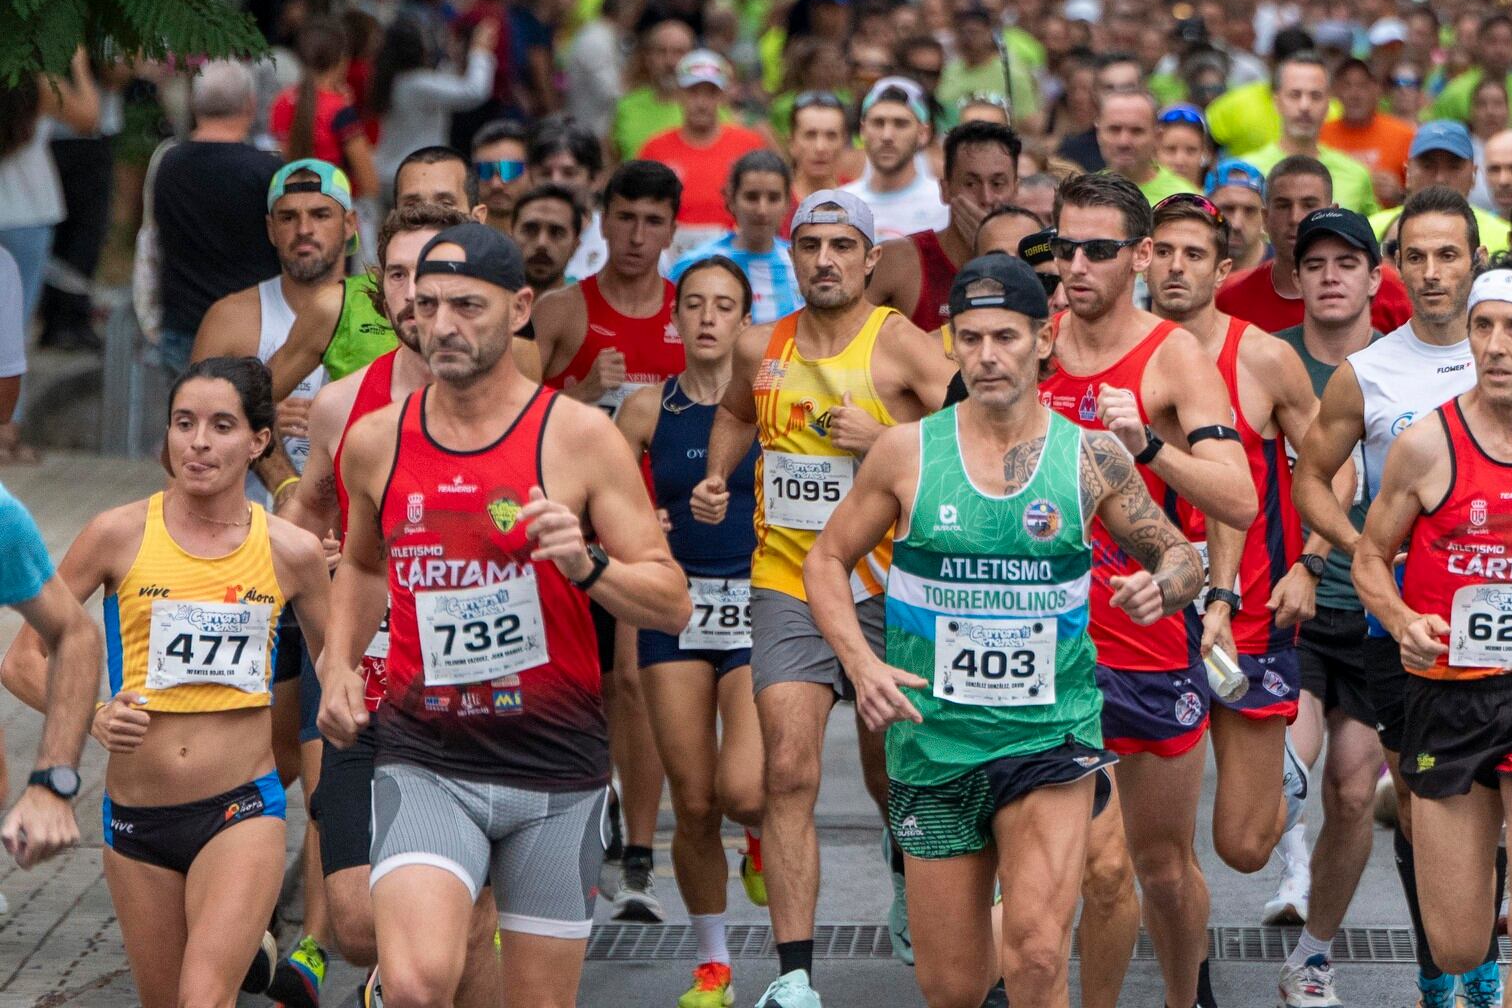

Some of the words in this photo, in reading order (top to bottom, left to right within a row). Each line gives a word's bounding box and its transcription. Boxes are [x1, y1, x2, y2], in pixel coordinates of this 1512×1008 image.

[1437, 364, 1464, 374] FLOWER
[772, 477, 840, 502] 1095
[1447, 543, 1505, 554] ATLETISMO
[940, 557, 1052, 581] ATLETISMO
[243, 587, 275, 604] Álora
[922, 585, 1067, 611] TORREMOLINOS
[434, 613, 523, 656] 732
[166, 633, 249, 666] 477
[952, 648, 1035, 679] 403
